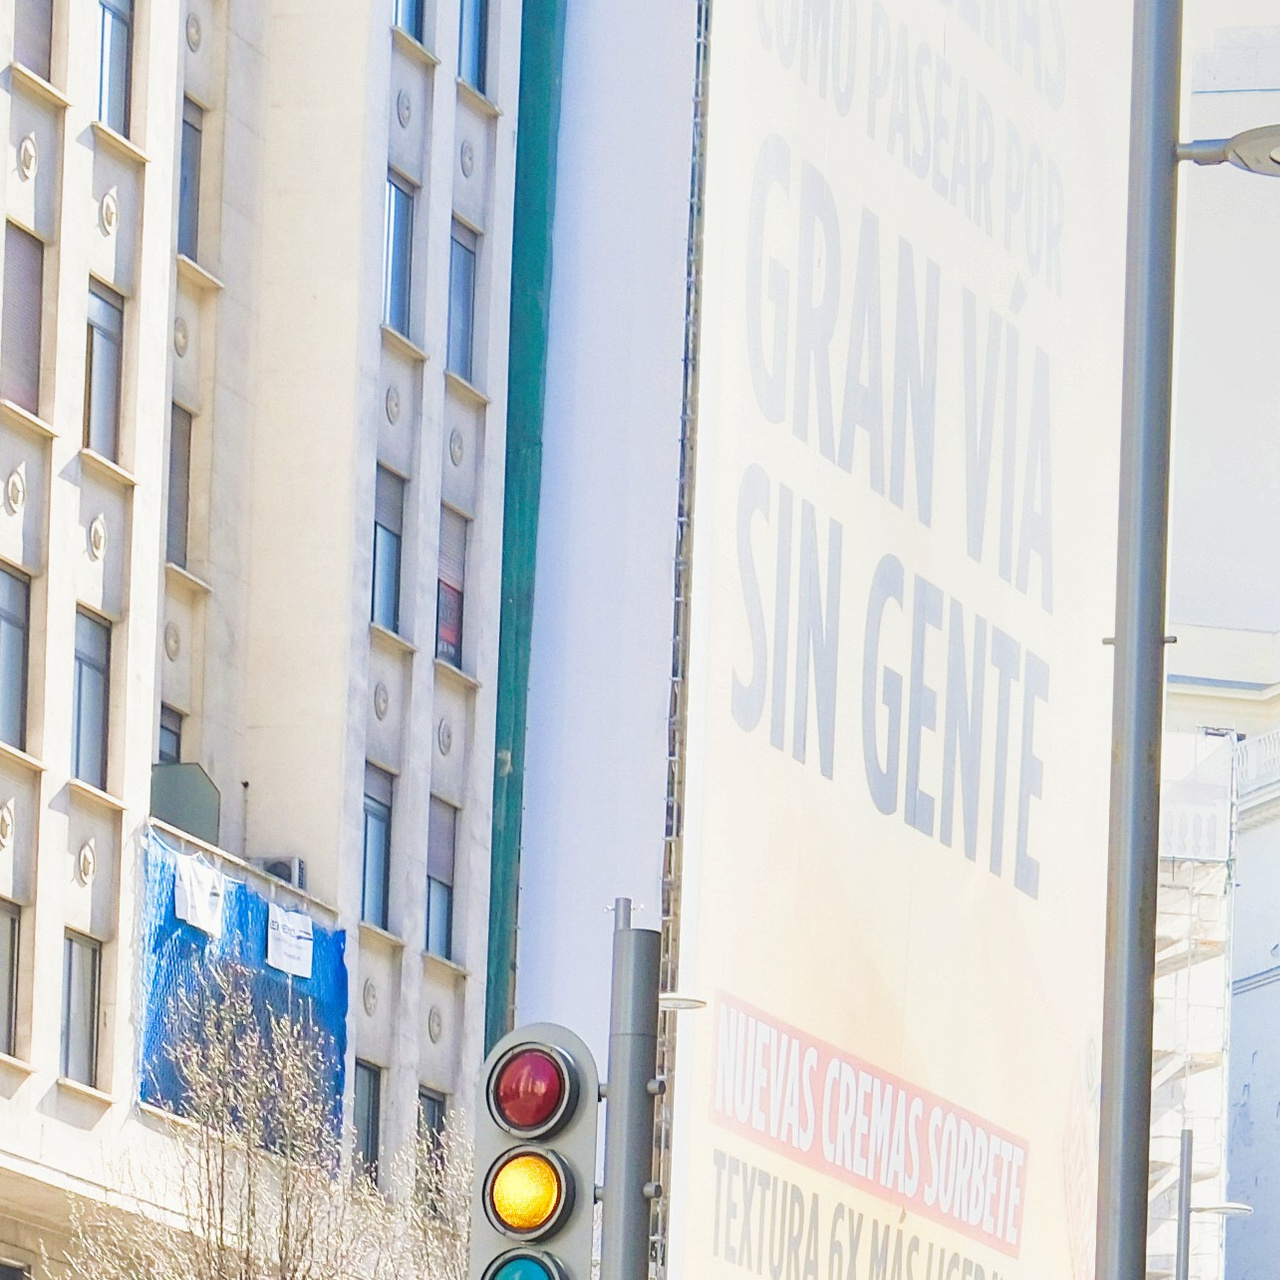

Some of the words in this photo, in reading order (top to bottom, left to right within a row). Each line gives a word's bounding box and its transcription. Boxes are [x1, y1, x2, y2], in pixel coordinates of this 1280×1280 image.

[866, 0, 995, 238] PASEAR
[1003, 118, 1065, 299] POR
[745, 131, 941, 529] GRAN
[961, 272, 1054, 616] VÍA
[731, 462, 844, 782] SIN
[861, 552, 1050, 901] GENTE
[714, 1002, 818, 1154] NUEVAS
[822, 1057, 923, 1198] CREMAS
[924, 1105, 1026, 1246] SORBETE
